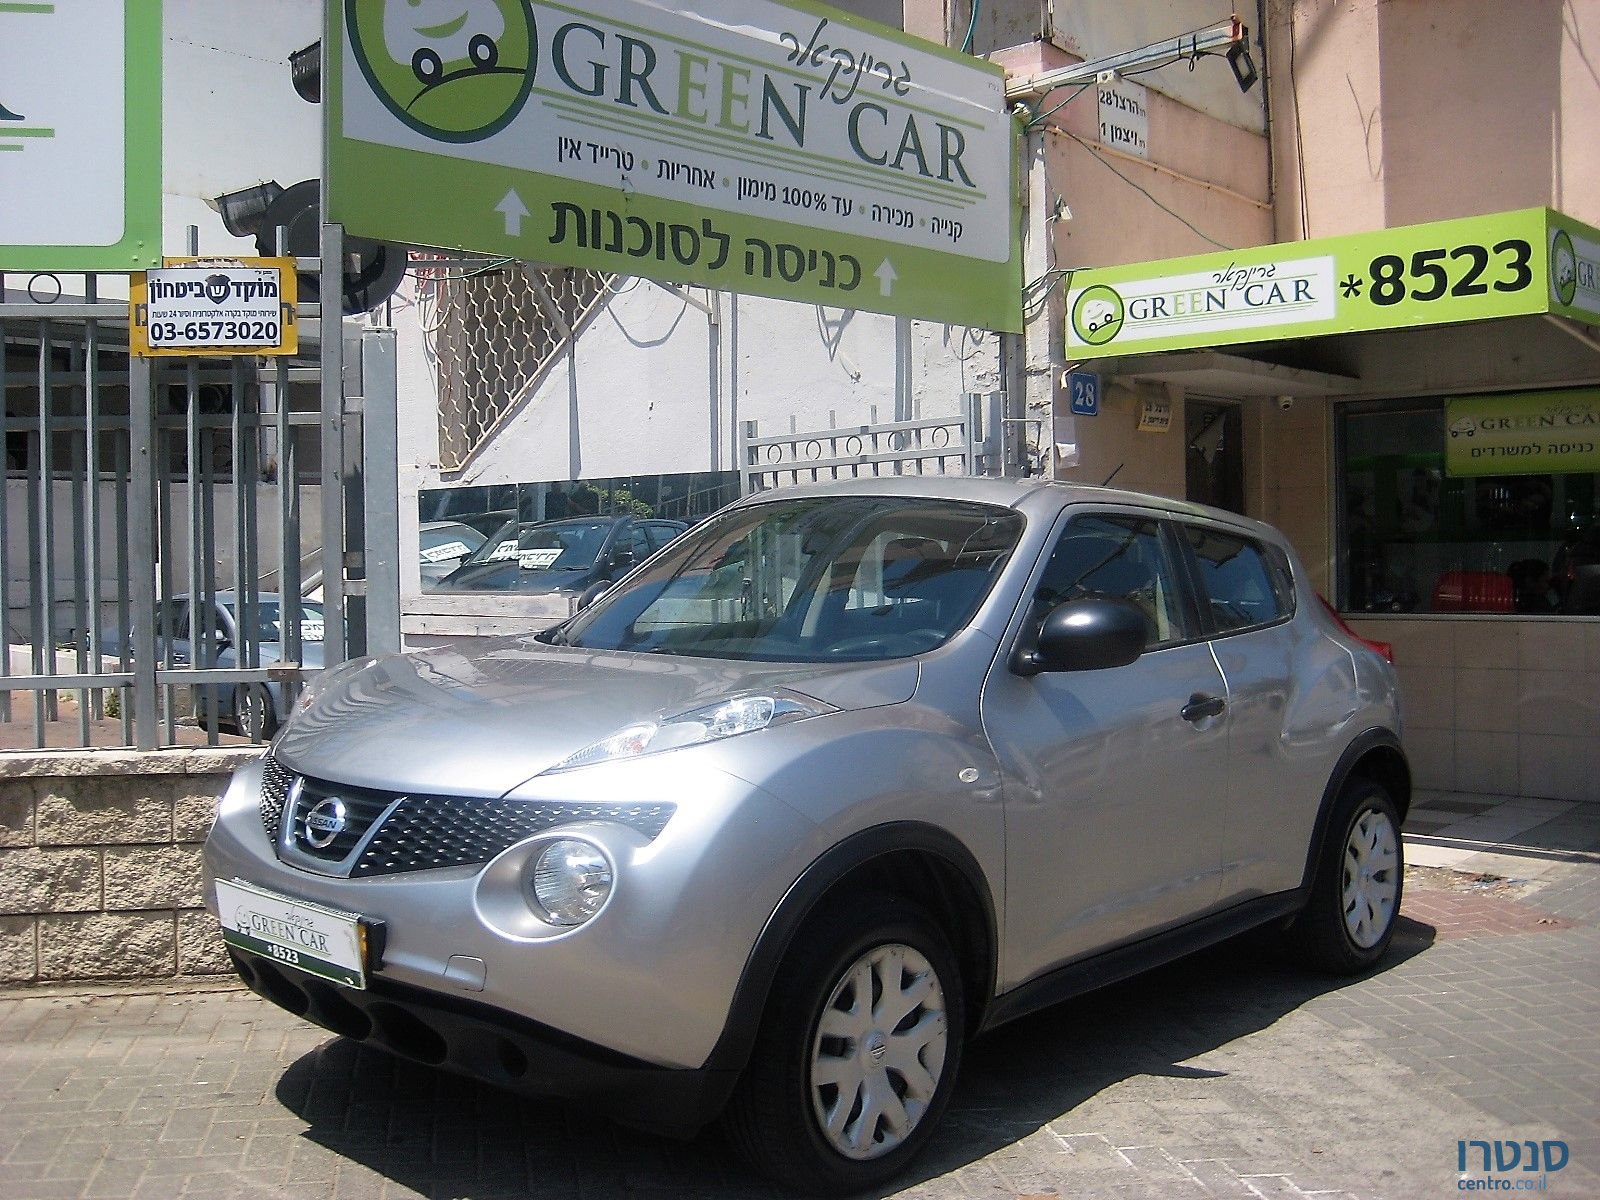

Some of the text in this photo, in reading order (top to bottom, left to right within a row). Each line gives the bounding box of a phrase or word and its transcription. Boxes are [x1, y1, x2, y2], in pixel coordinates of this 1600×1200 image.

[780, 18, 912, 105] גרינקאר
[551, 22, 976, 188] GREEN CAR
[1101, 122, 1106, 136] 1
[1110, 125, 1138, 146] ויצמן
[558, 136, 963, 242] קנייה מכירה עד 100% מימון אחריות טרייד אין
[548, 202, 861, 291] כניסה לסוכנות
[1212, 261, 1276, 291] גרינקאר
[1578, 260, 1600, 291] GR
[149, 278, 206, 304] ביטחון
[1129, 279, 1316, 320] GREEN CAR
[169, 310, 177, 318] 24
[224, 310, 241, 319] בקרה
[150, 321, 278, 341] 03-6573020
[1075, 381, 1095, 407] 28
[1471, 442, 1594, 458] כניסה למשרדים
[251, 914, 329, 952] GREEN CAR
